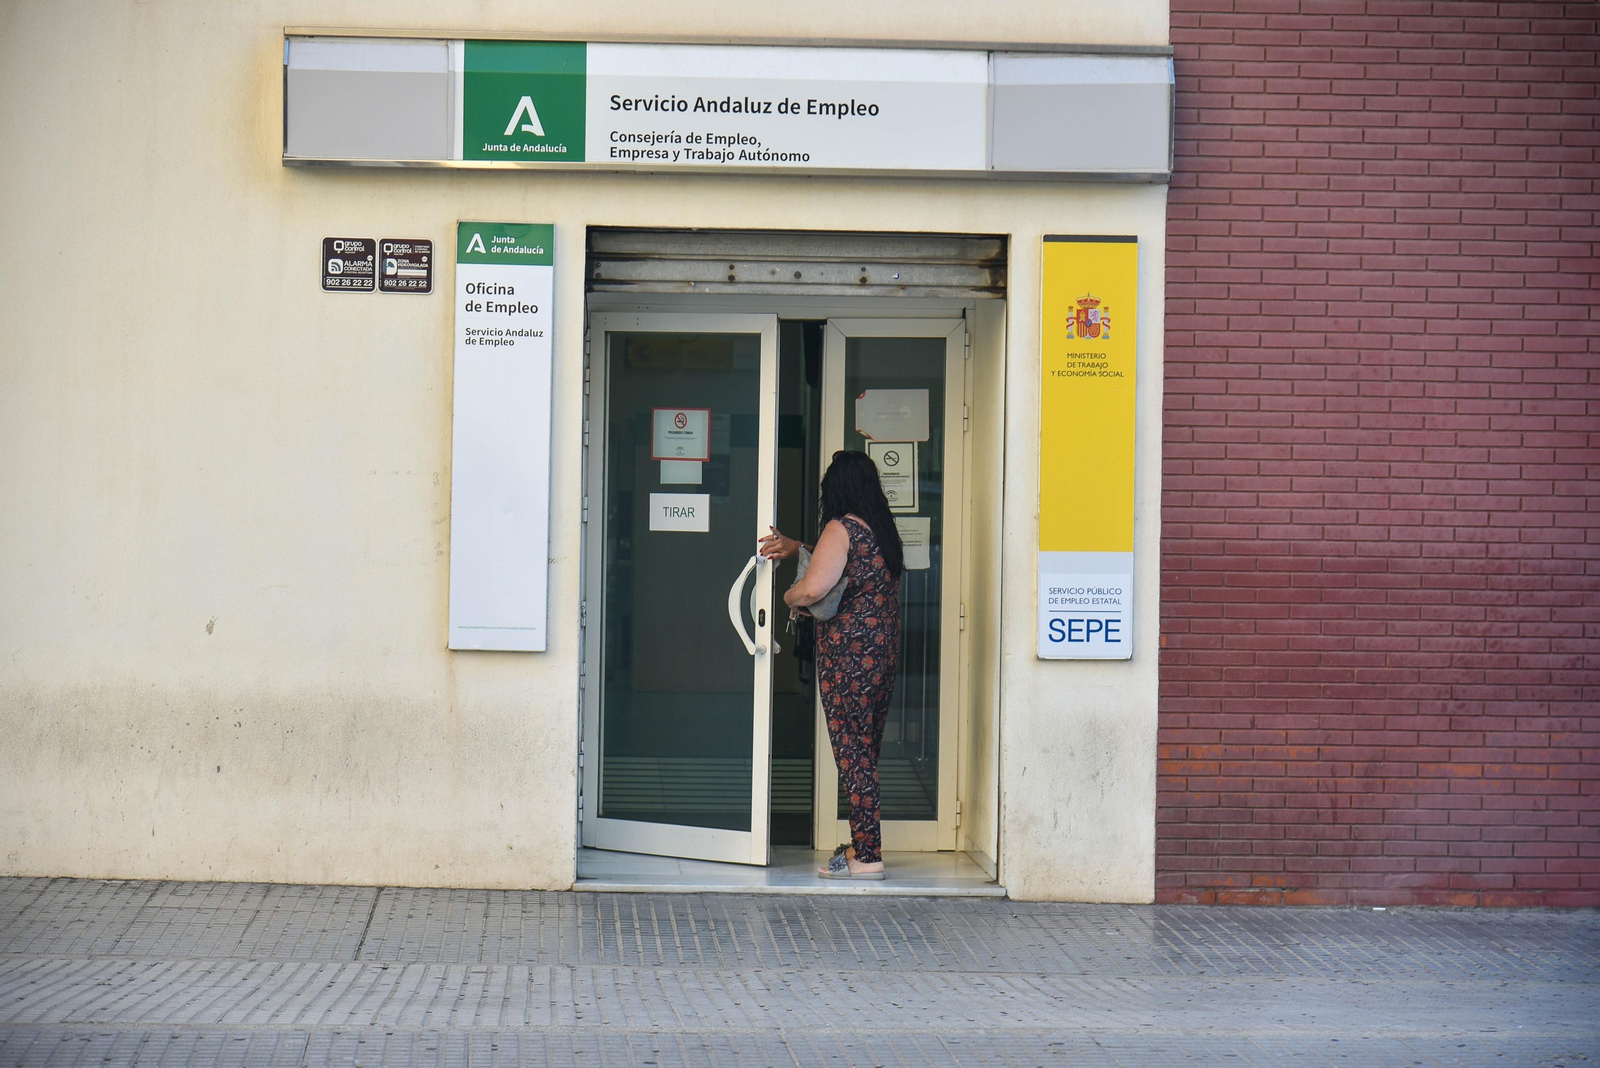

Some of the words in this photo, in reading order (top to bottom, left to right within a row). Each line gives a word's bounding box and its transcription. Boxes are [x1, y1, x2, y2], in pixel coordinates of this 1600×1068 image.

[609, 94, 688, 114] Servicio
[693, 95, 772, 115] Andaluz
[777, 96, 801, 116] de
[807, 98, 880, 120] Empleo
[609, 130, 682, 148] Consejería
[685, 131, 703, 145] de
[706, 131, 761, 148] Empleo,
[482, 143, 508, 152] Junta
[509, 143, 521, 152] de
[522, 143, 567, 153] Andalucía
[609, 146, 670, 163] Empresa
[671, 150, 681, 163] y
[683, 147, 735, 164] Trabajo
[738, 147, 810, 163] Autónomo
[491, 235, 515, 244] Junta
[503, 246, 544, 255] Andalucía
[326, 278, 340, 286] 902
[352, 279, 362, 287] 22
[363, 279, 373, 287] 22
[465, 282, 515, 296] Oficina
[465, 300, 482, 313] de
[486, 301, 539, 316] Empleo
[465, 327, 503, 337] Servicio
[505, 328, 544, 338] Andaluz
[465, 337, 477, 346] de
[479, 338, 515, 348] Empleo
[1066, 352, 1107, 360] MINISTERIO
[1066, 361, 1077, 369] DE
[1078, 361, 1109, 370] TRABAJO
[1057, 369, 1097, 377] ECONOMÍA
[1098, 370, 1124, 378] SOCIAL
[662, 506, 695, 518] TIRAR
[1048, 587, 1085, 595] SERVICIO
[1086, 586, 1123, 596] PÚBLICO
[1048, 597, 1059, 605] DE
[1060, 597, 1090, 605] EMPLEO
[1048, 618, 1122, 643] SEPE
